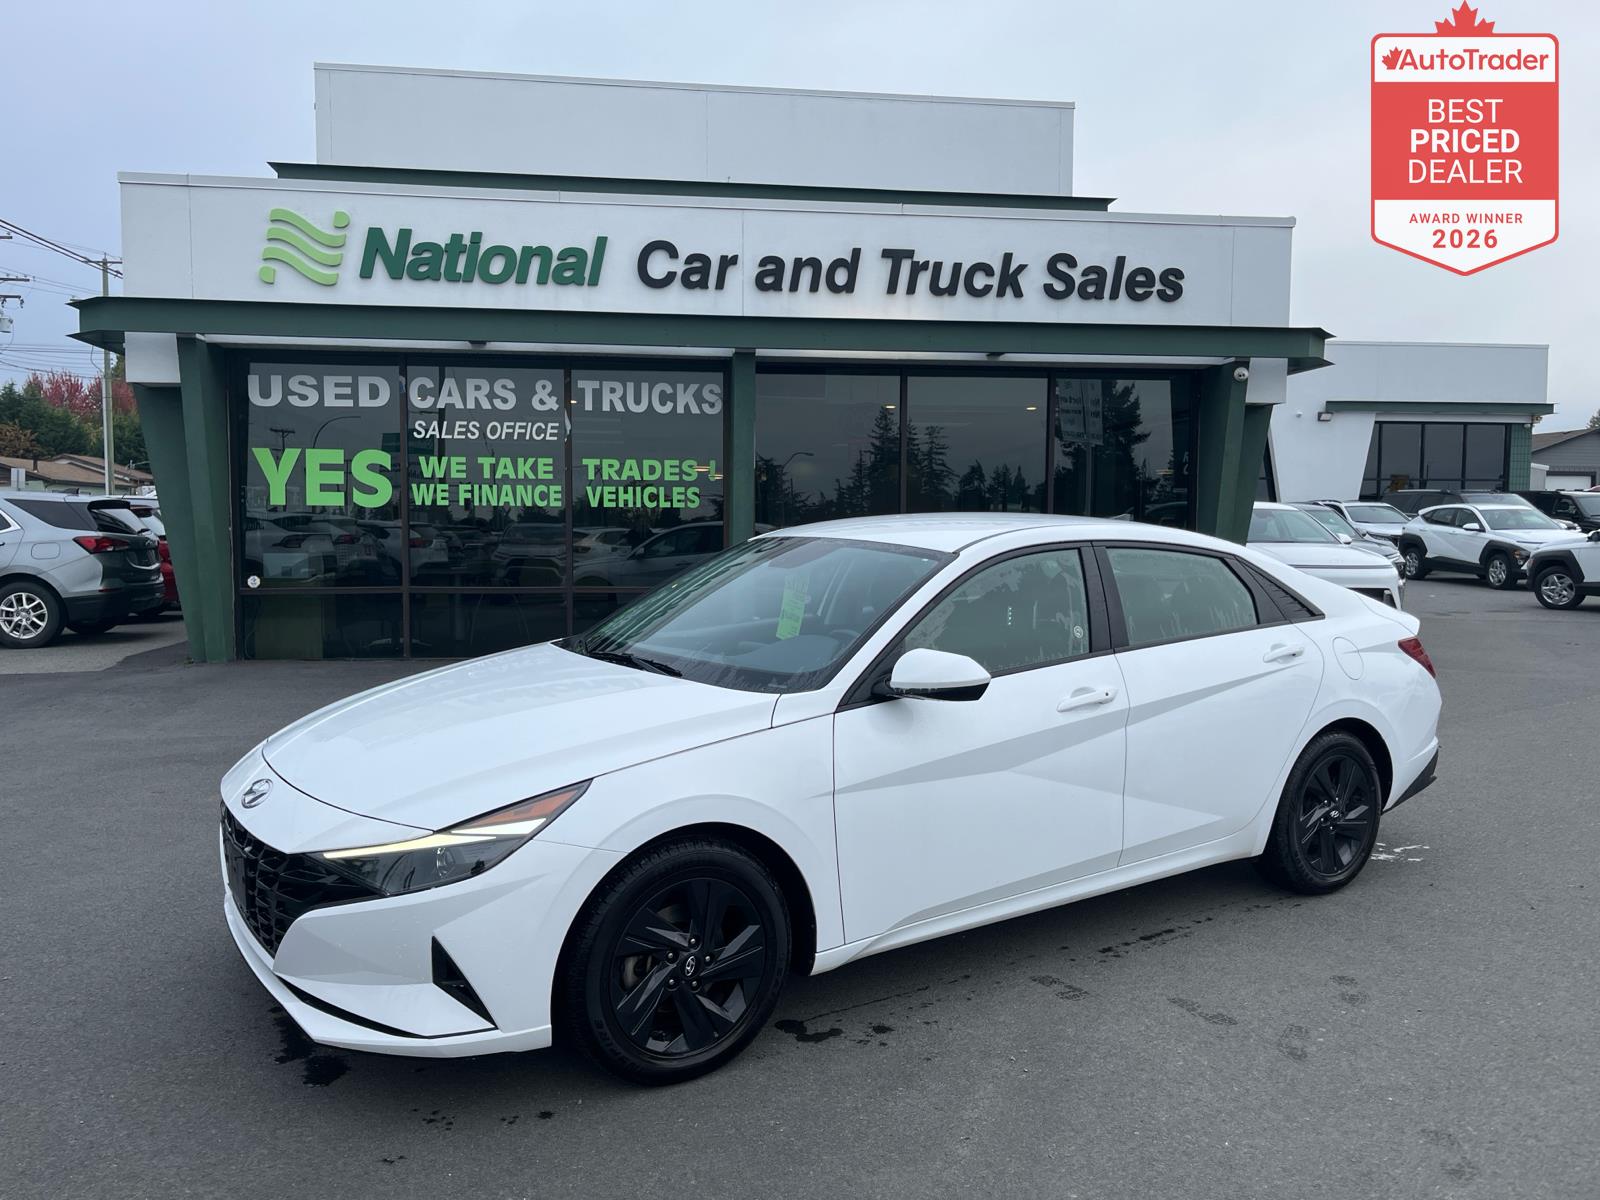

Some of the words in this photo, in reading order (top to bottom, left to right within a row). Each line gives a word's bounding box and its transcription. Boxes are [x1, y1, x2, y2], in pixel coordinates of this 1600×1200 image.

[360, 228, 608, 286] National
[638, 240, 738, 290] Car
[755, 248, 861, 294] and
[881, 249, 1028, 298] Truck
[1043, 253, 1184, 303] Sales
[249, 375, 390, 407] USED
[410, 377, 516, 410] CARS
[532, 380, 559, 411] &
[578, 381, 721, 414] TRUCKS
[414, 421, 479, 439] SALES
[487, 422, 559, 440] OFFICE
[253, 448, 392, 507] YES
[420, 456, 464, 478] WE
[479, 457, 552, 479] TAKE
[582, 459, 696, 480] TRADES
[412, 484, 448, 505] WE
[459, 484, 560, 506] FINANCE
[587, 486, 699, 508] VEHICLES
